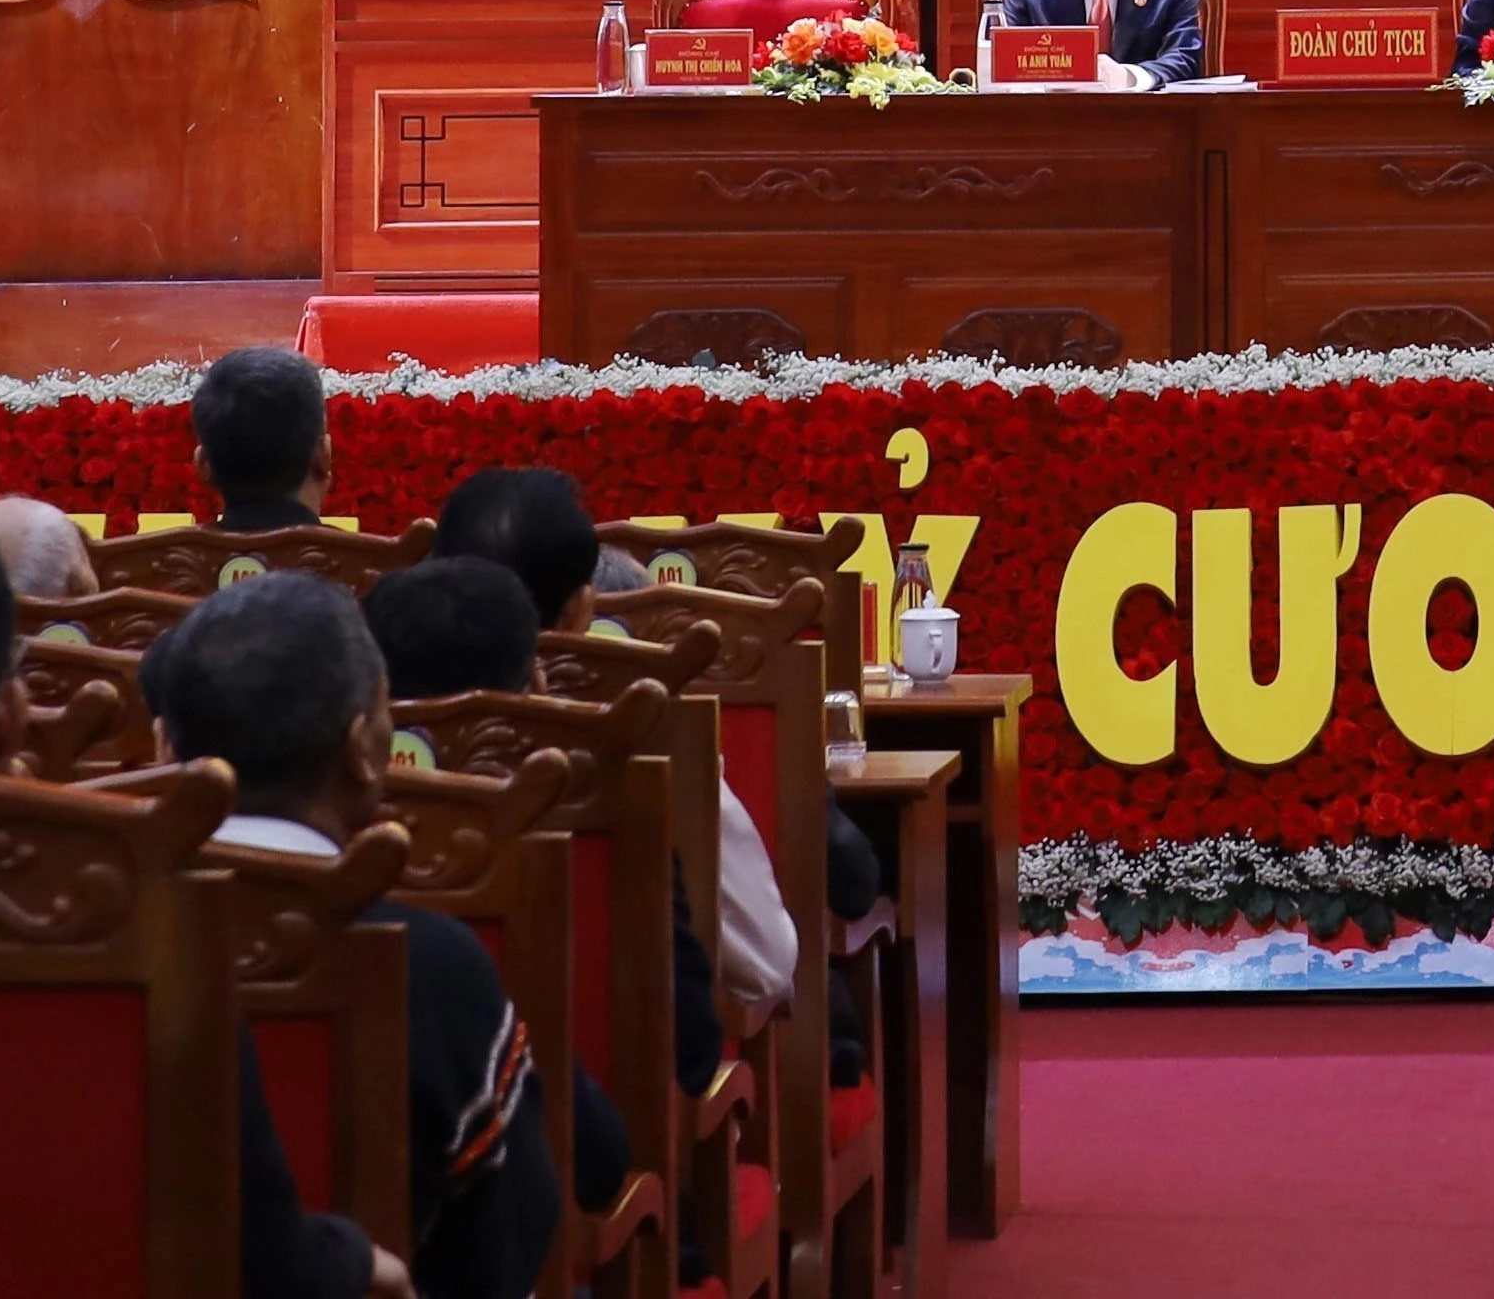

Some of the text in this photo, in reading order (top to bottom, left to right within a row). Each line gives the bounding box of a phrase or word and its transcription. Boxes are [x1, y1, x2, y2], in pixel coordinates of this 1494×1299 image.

[1289, 23, 1426, 64] ĐOÀN CHỦ TỊCH
